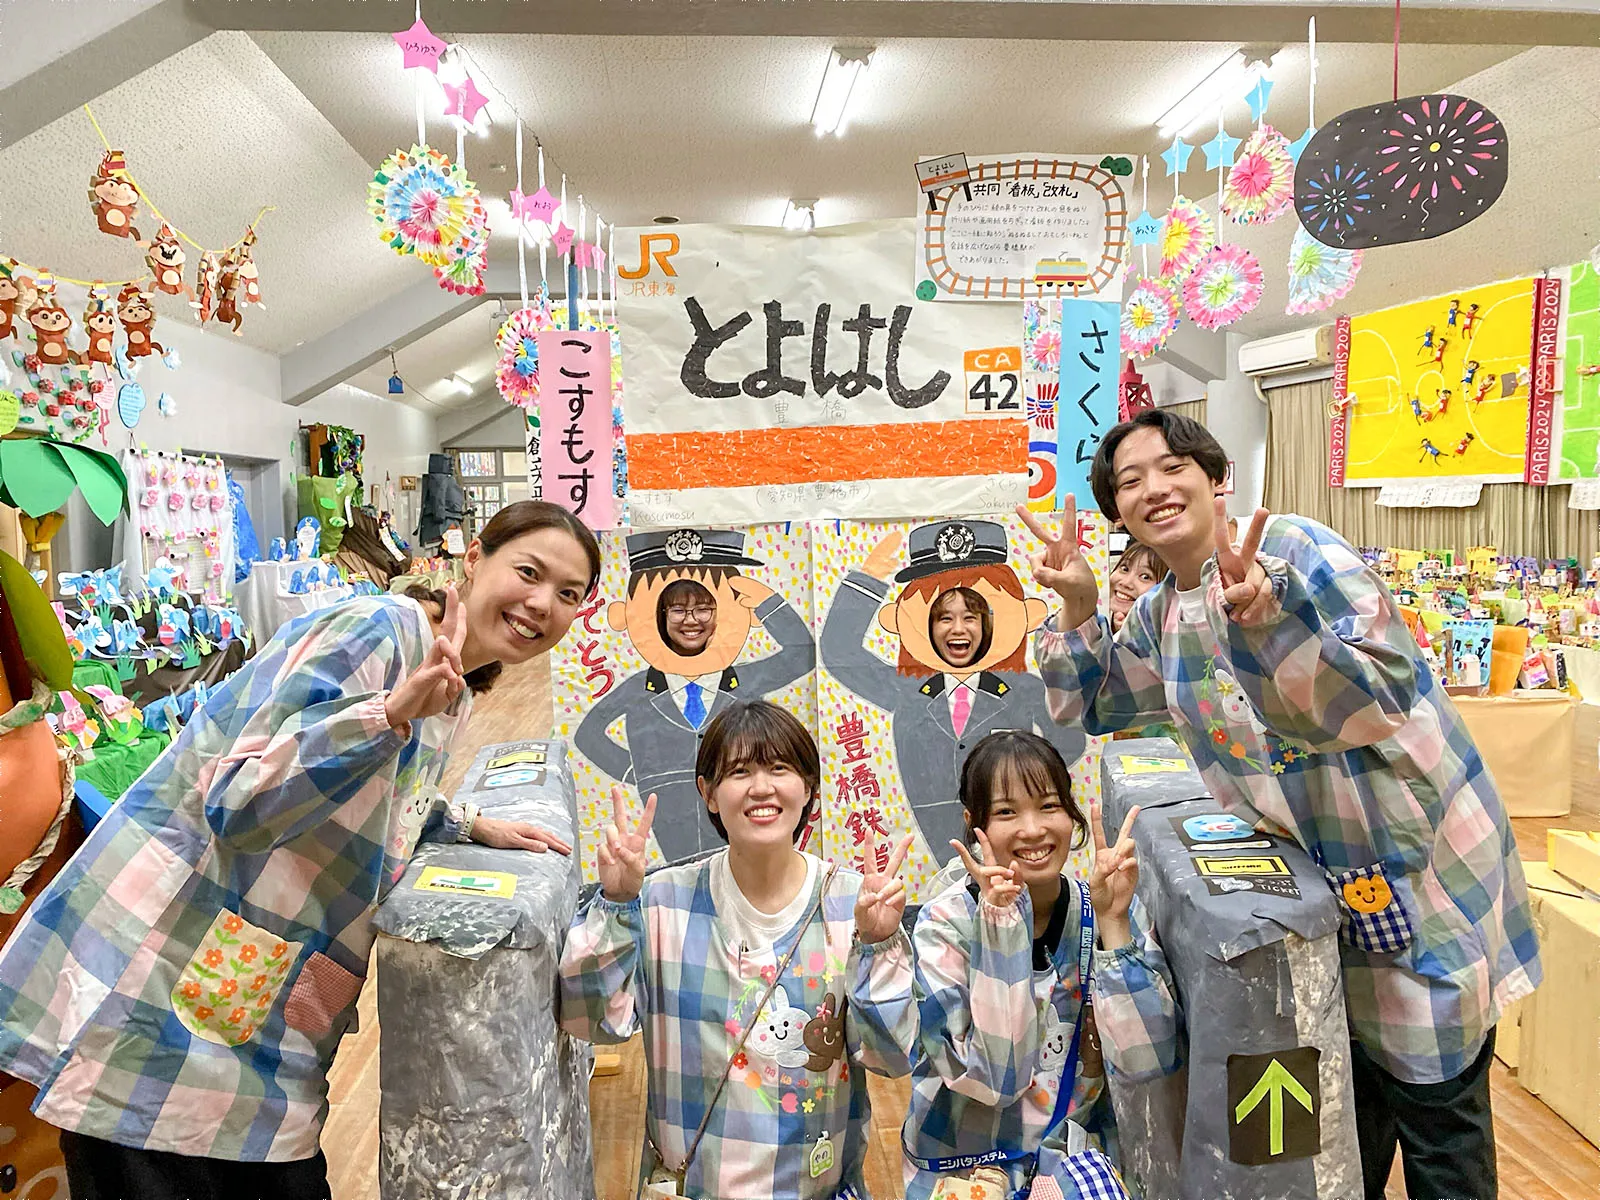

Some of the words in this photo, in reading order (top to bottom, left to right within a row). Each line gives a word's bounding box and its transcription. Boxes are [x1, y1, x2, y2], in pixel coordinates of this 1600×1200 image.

[405, 42, 437, 56] ひろゆき
[618, 233, 681, 279] JR
[624, 281, 677, 297] JR東海
[680, 296, 952, 409] とよはし
[974, 353, 1012, 369] CA
[969, 373, 1019, 411] 42
[557, 339, 595, 516] こすもす
[575, 584, 615, 699] でとう
[1259, 883, 1301, 895] TICKET
[938, 1150, 1008, 1171] ニシハタシステム
